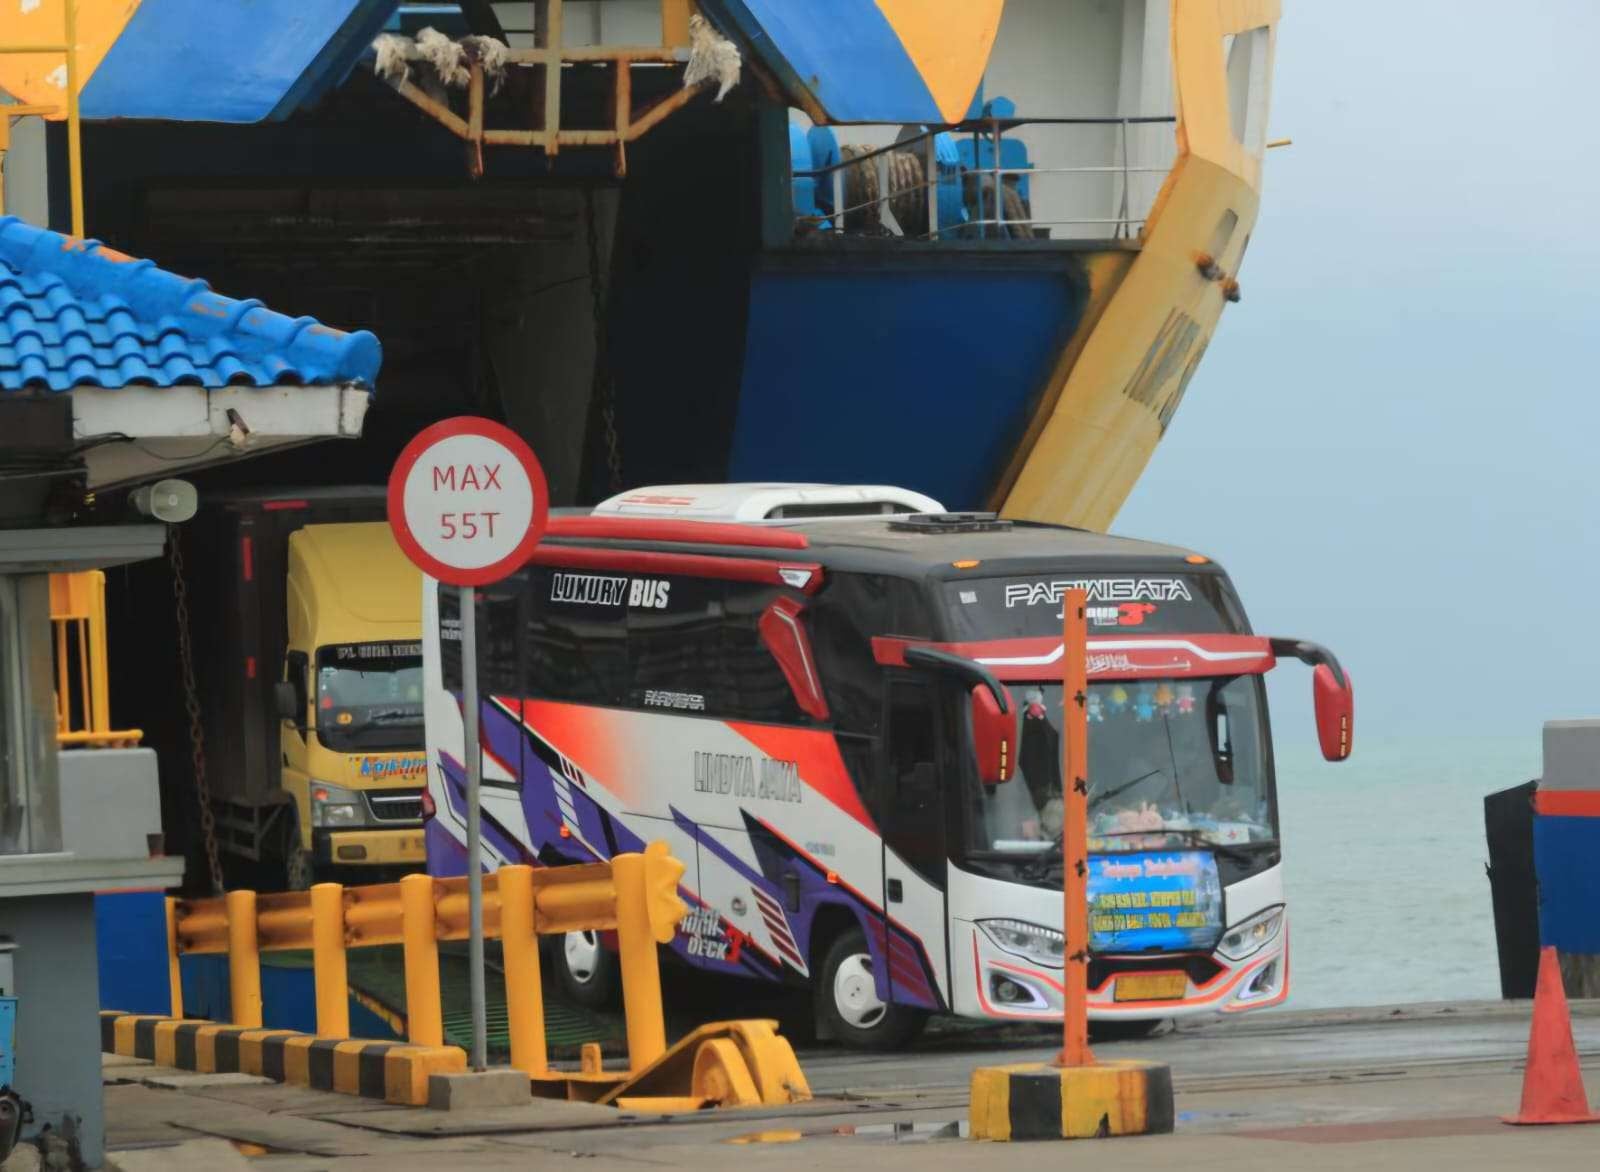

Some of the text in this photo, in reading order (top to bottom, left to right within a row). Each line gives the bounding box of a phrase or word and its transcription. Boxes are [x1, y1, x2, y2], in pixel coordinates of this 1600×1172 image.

[433, 464, 502, 491] MAX
[441, 512, 502, 540] 55T
[551, 573, 671, 609] LUXURY BUS
[1006, 579, 1193, 608] PARWISATA
[687, 935, 727, 961] DECK
